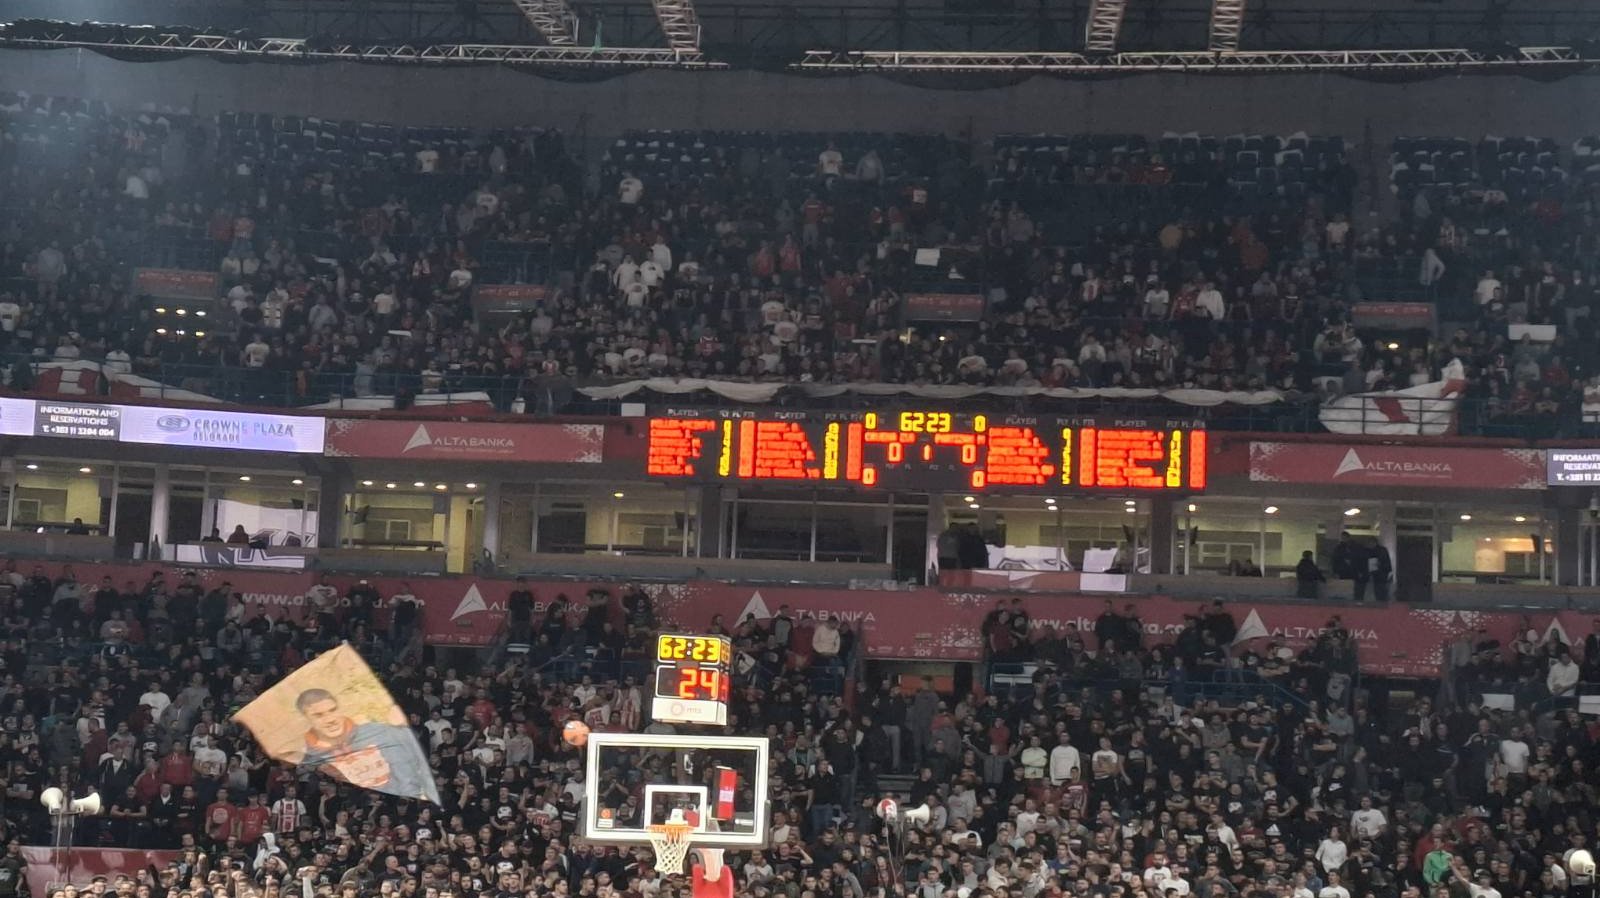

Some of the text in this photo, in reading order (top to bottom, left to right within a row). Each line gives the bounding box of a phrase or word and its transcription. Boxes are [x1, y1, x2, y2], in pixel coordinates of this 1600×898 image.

[40, 406, 119, 418] INFORMATION AND
[50, 415, 108, 425] RESERVATIONS
[667, 408, 699, 417] PLAYER
[775, 411, 806, 420] PLAYER
[194, 419, 247, 433] CROWNE
[865, 413, 876, 429] 0
[974, 415, 986, 432] 0
[1005, 417, 1037, 425] PLAYER
[1114, 419, 1147, 427] PLAYER
[433, 437, 515, 448] ALTABANKA
[888, 442, 902, 462] 0
[923, 444, 931, 461] 1
[962, 444, 976, 464] 0
[1365, 461, 1453, 473] ALTABANKA
[863, 467, 875, 485] 0
[972, 470, 985, 488] 0
[660, 637, 719, 661] 62:23
[679, 668, 719, 700] 24
